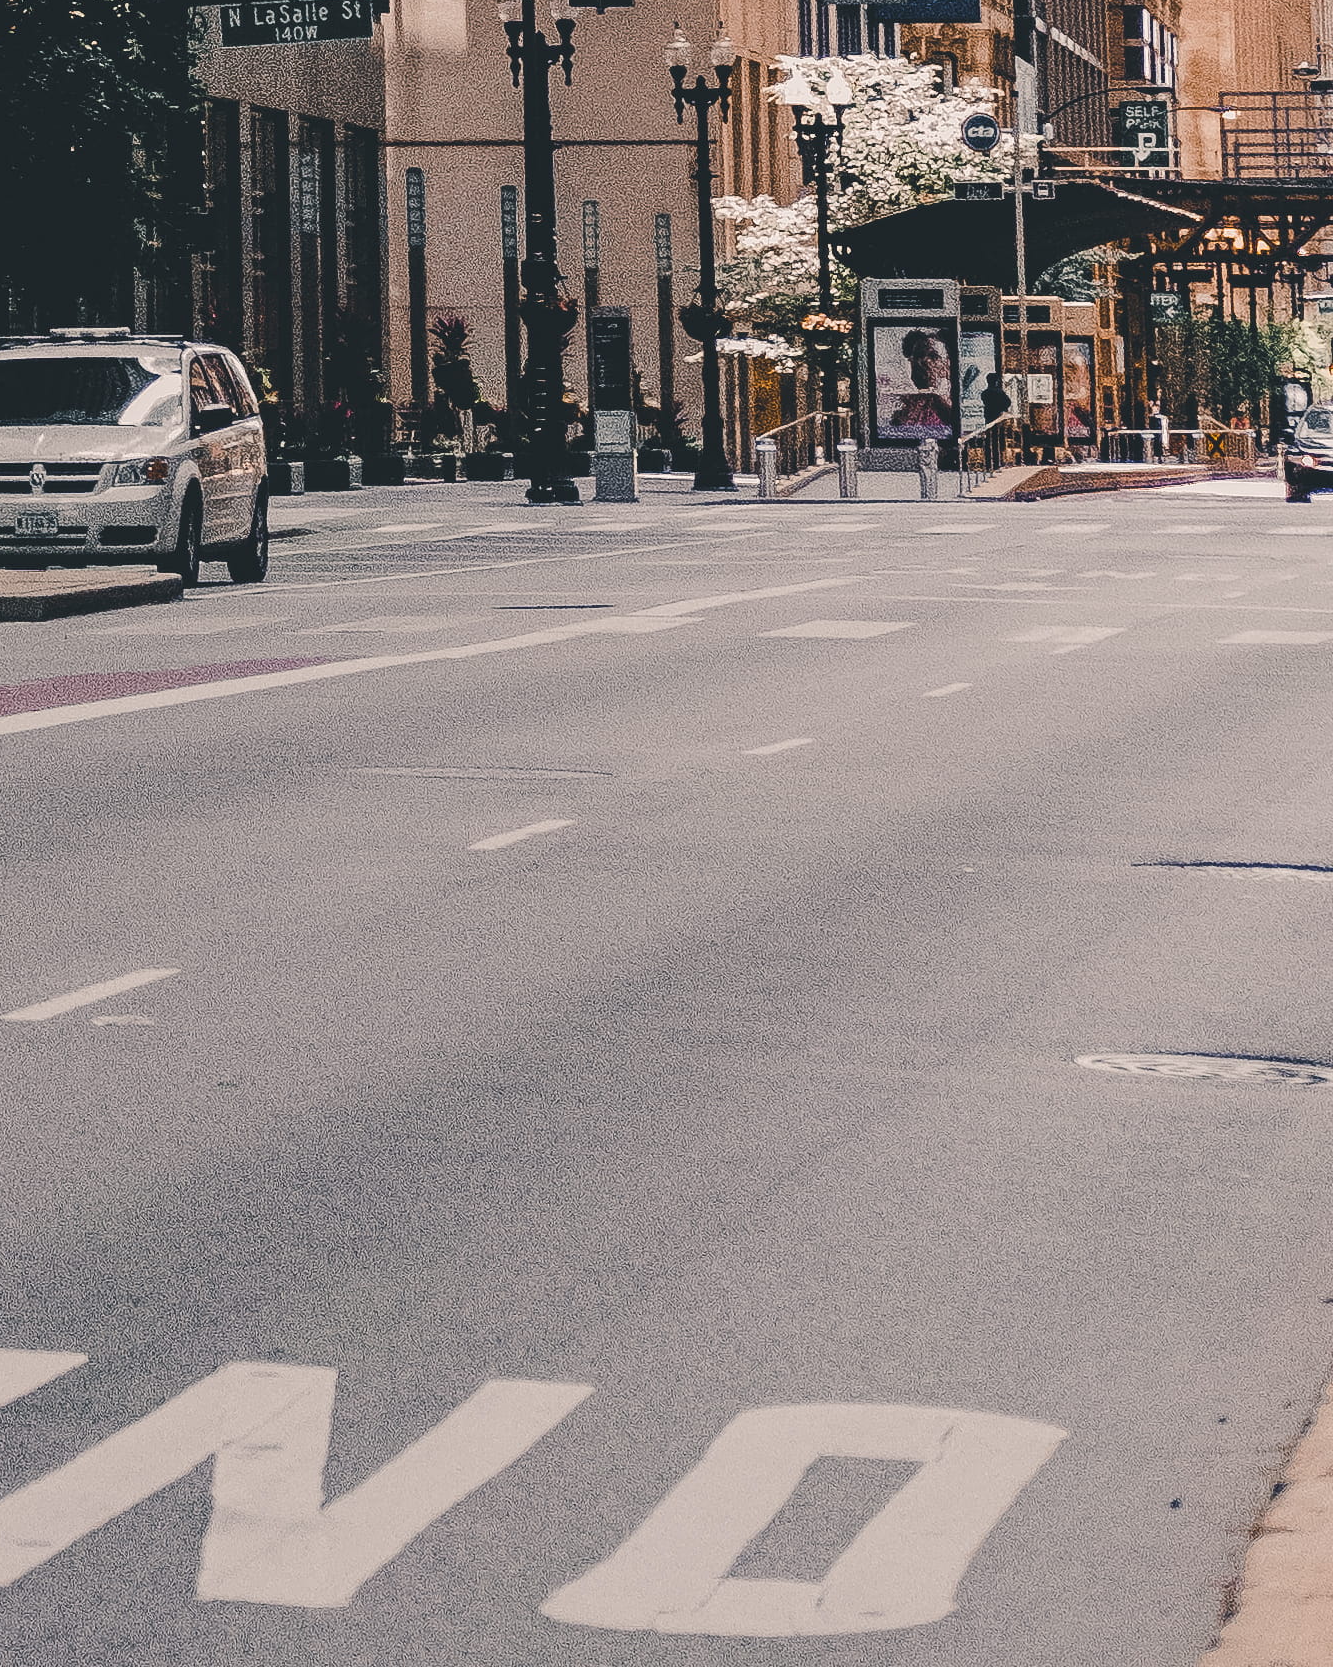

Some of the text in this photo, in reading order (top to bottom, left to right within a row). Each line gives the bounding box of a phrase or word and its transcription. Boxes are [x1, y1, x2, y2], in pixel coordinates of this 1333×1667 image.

[228, 0, 363, 28] N LaSalle St
[275, 25, 319, 42] 140W
[1125, 105, 1159, 118] SELF
[967, 124, 995, 139] cta
